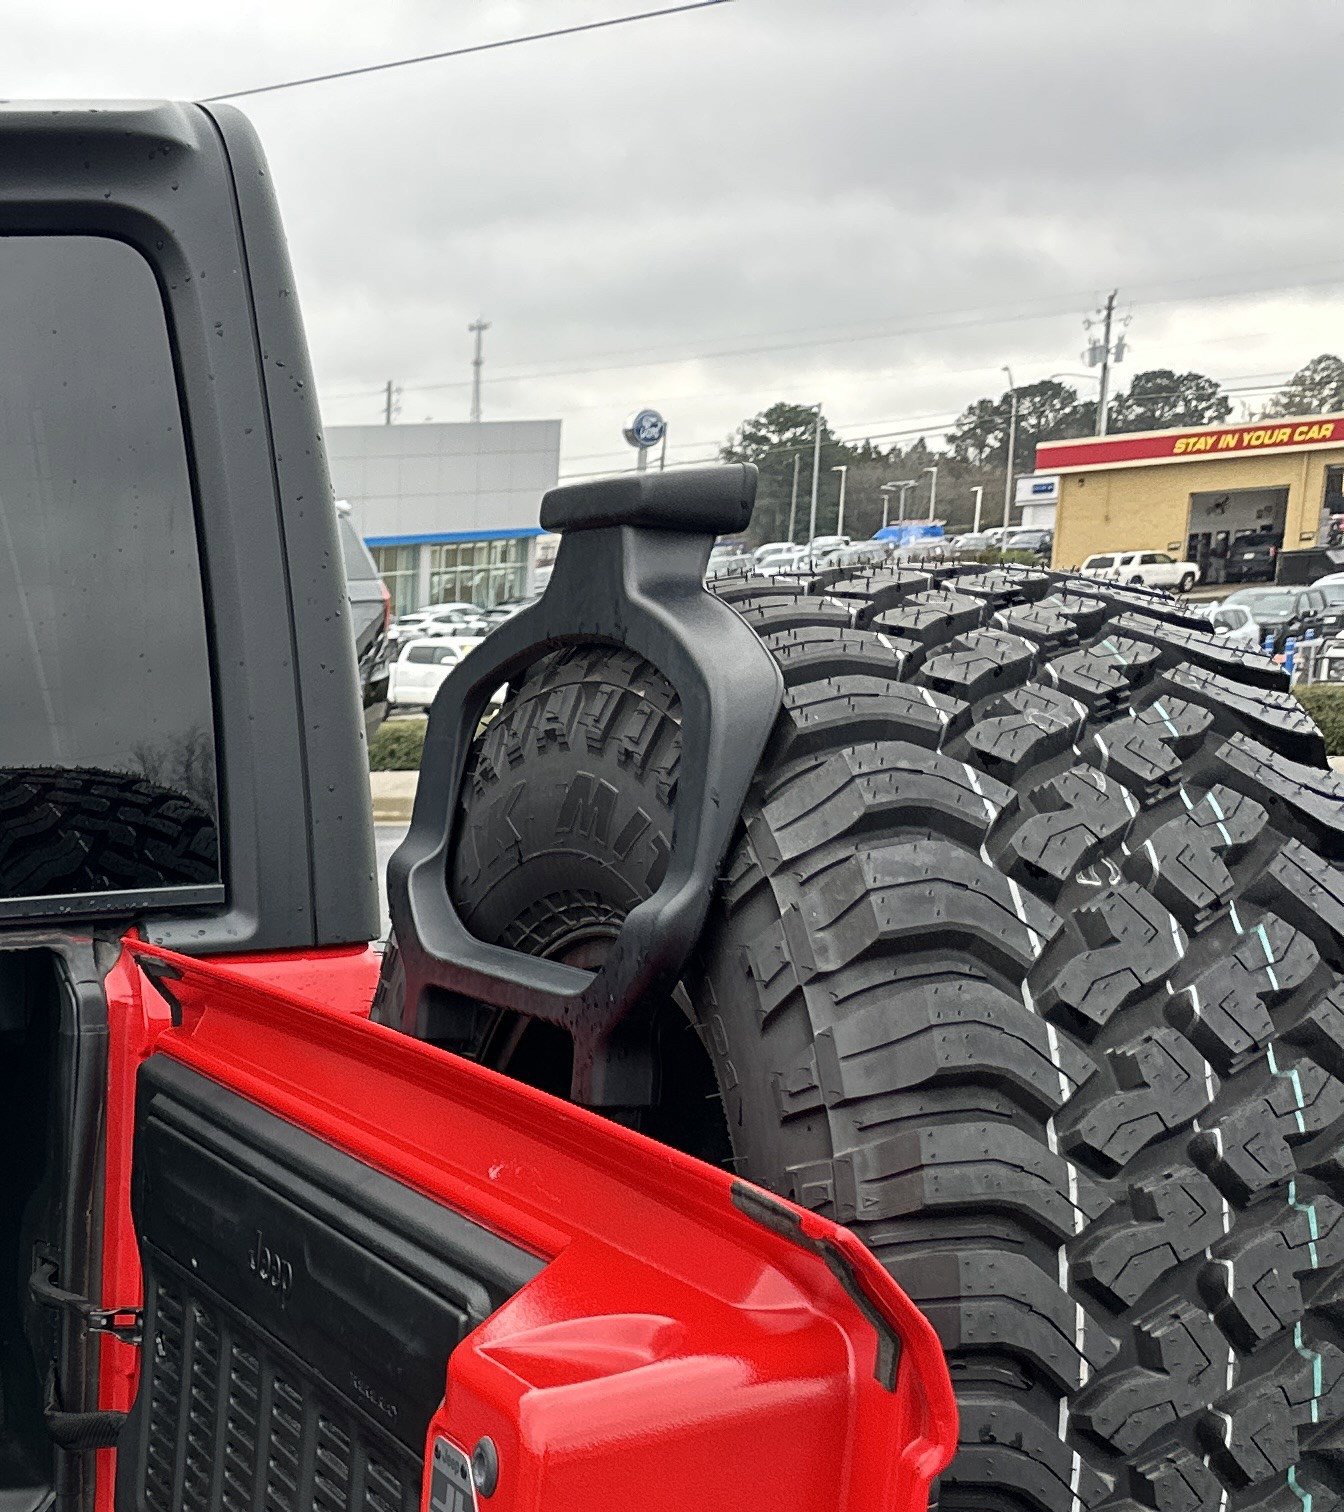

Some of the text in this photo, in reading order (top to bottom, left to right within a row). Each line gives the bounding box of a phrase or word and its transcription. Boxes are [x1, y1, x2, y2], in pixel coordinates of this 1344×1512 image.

[1173, 422, 1335, 454] STAY IN YOUR CAR
